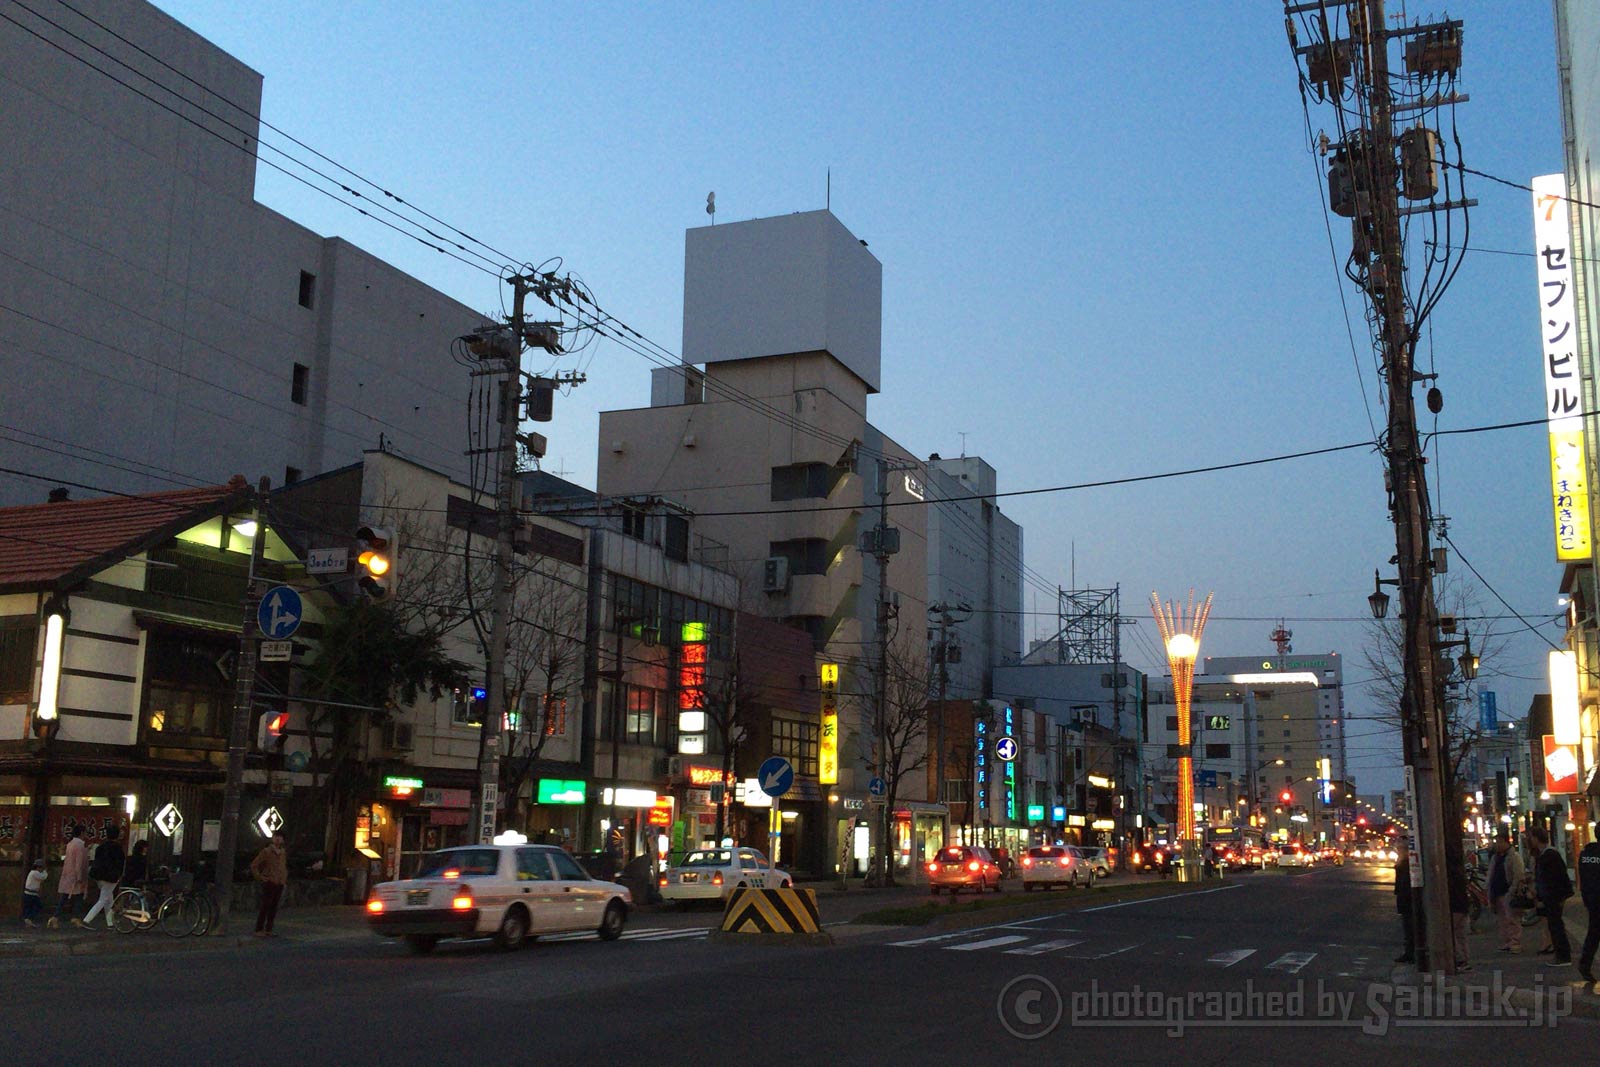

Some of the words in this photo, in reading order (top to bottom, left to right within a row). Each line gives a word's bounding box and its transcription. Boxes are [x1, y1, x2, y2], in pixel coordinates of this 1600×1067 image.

[1537, 194, 1560, 221] 7
[1541, 244, 1579, 415] セブンビル
[1556, 480, 1575, 550] まねきねこ
